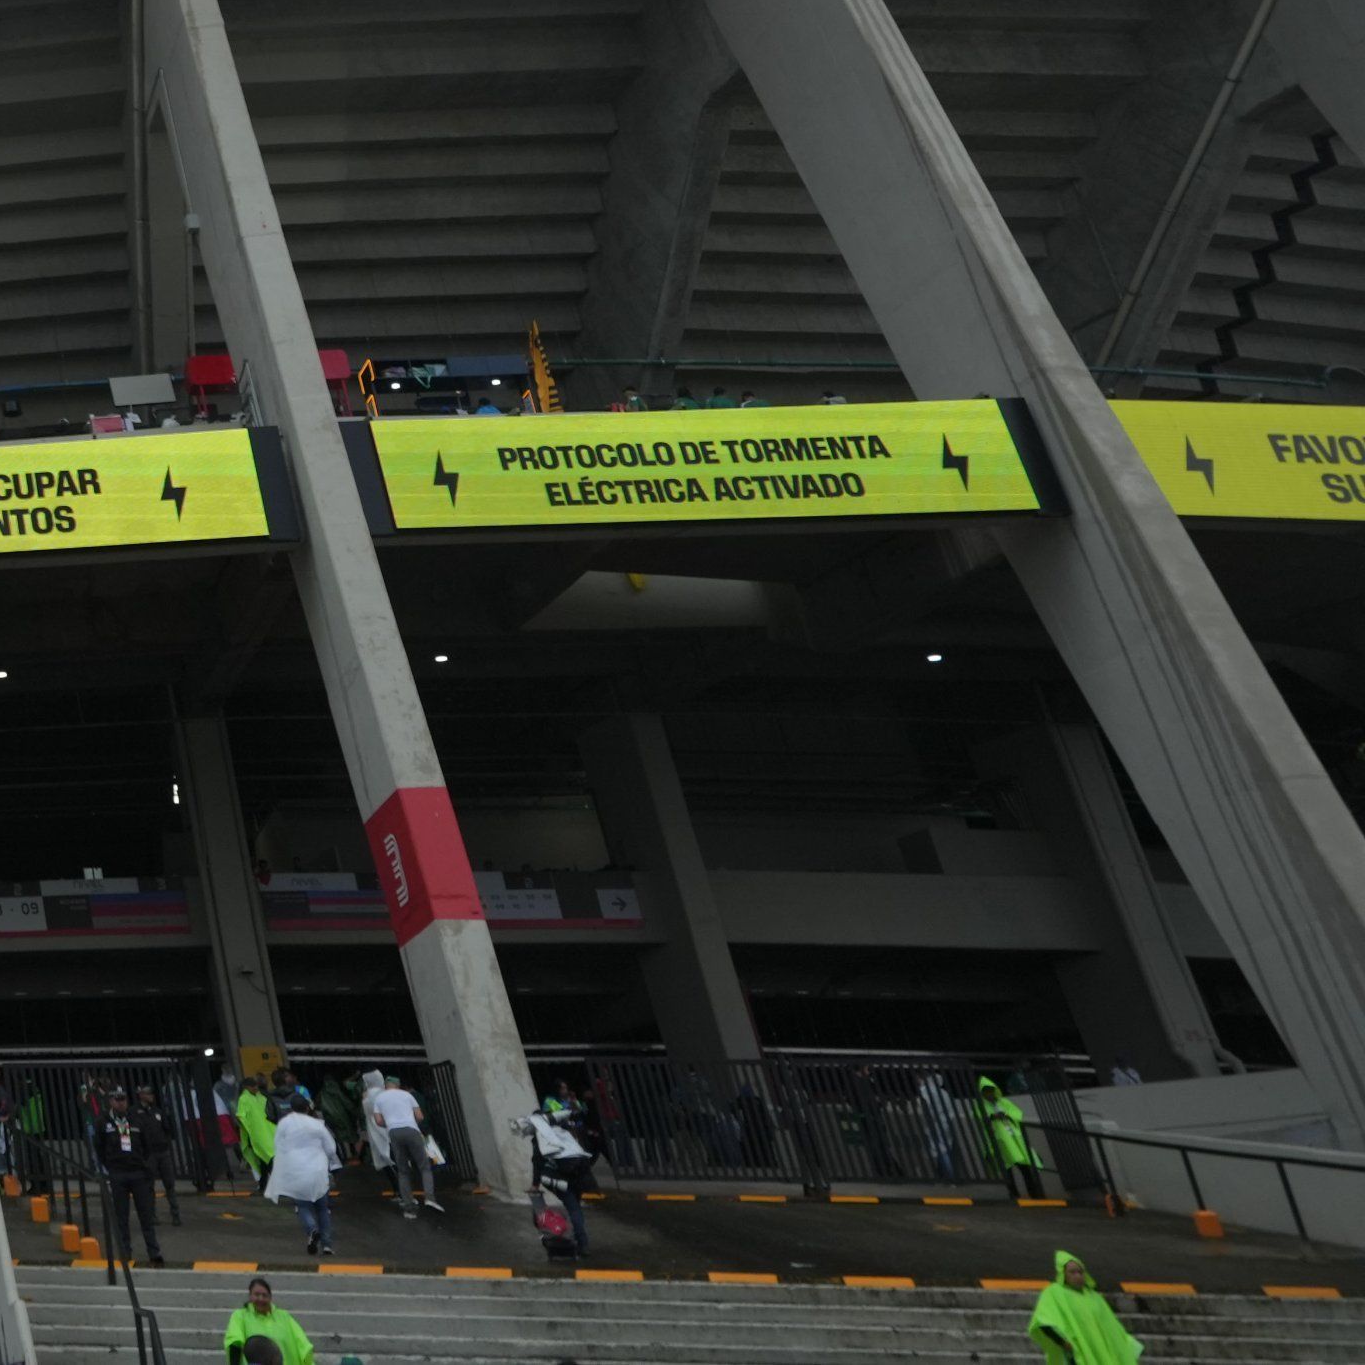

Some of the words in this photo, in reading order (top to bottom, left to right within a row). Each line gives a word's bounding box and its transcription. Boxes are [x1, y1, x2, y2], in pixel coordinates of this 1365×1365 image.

[497, 441, 676, 471] PROTOCOLO
[678, 440, 721, 465] DE
[721, 435, 892, 464] TORMENTA
[1267, 434, 1365, 466] FAVO
[544, 475, 710, 507] ELÉCTRICA
[713, 472, 866, 502] ACTIVADO
[21, 902, 39, 915] 09
